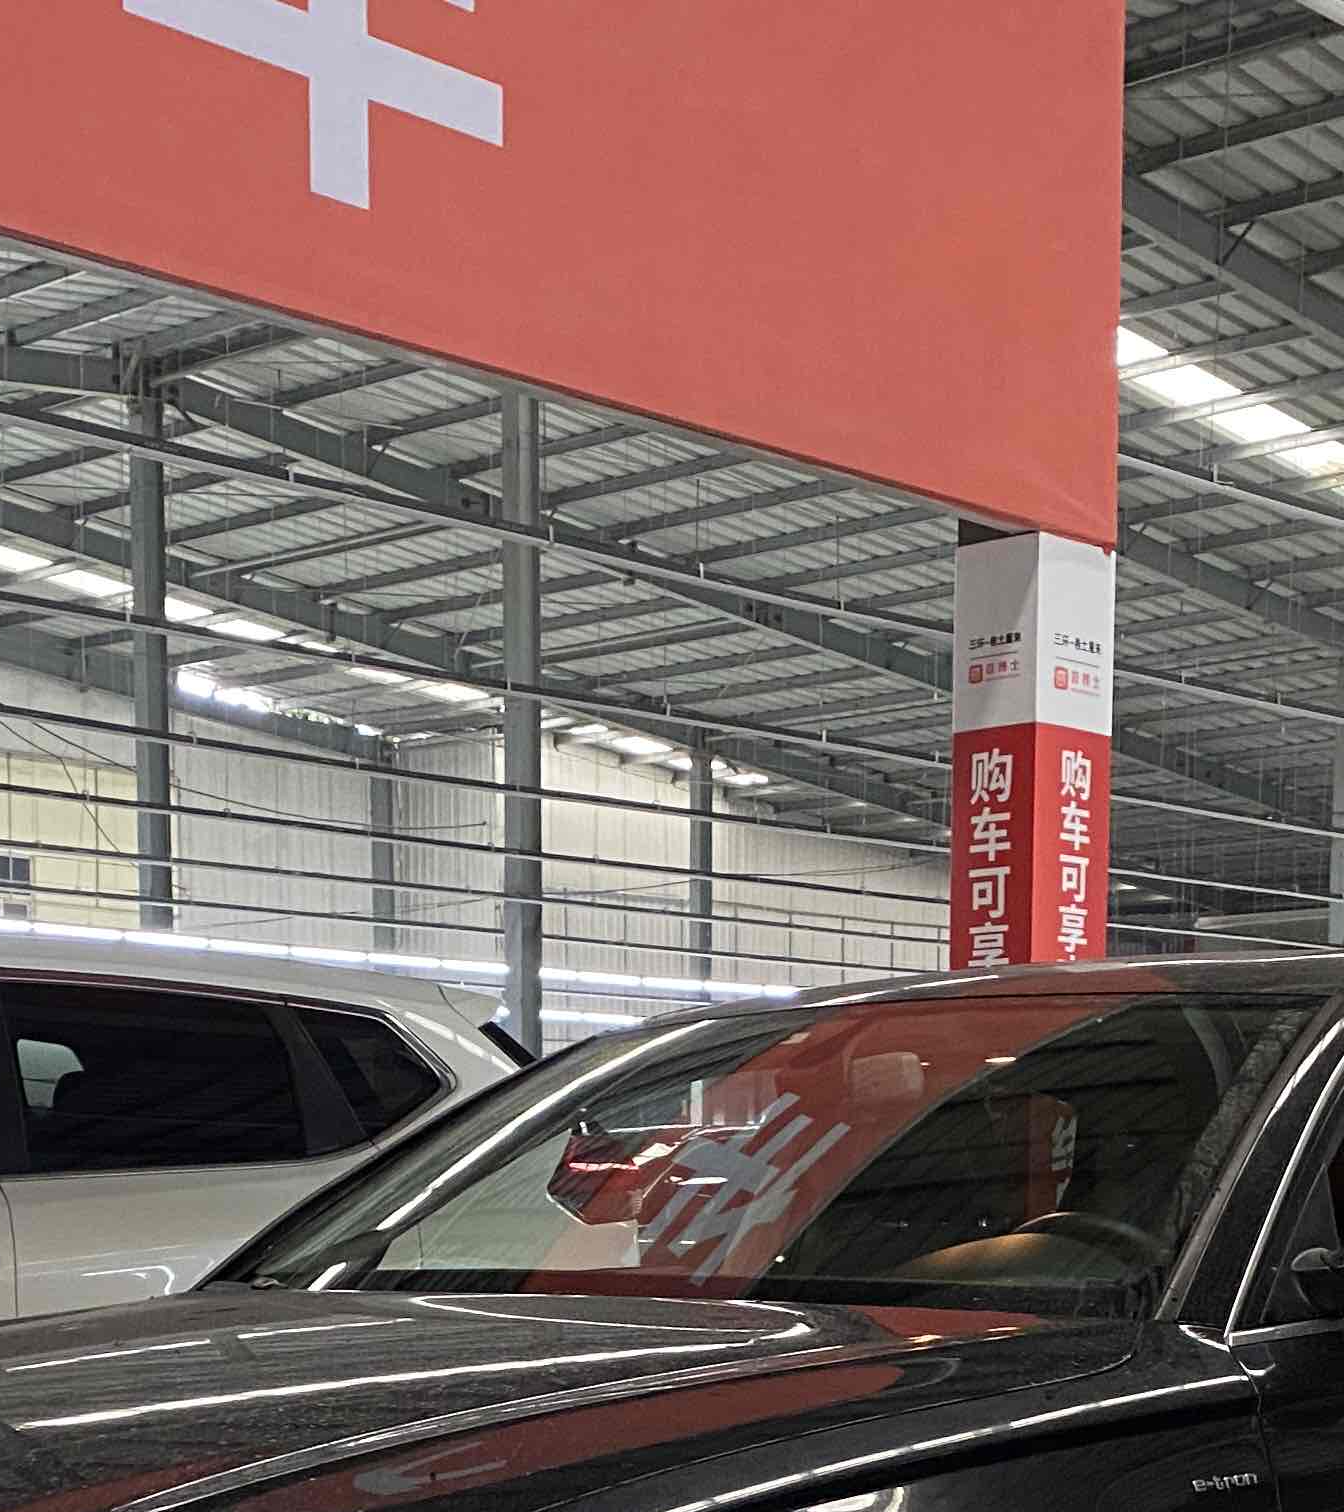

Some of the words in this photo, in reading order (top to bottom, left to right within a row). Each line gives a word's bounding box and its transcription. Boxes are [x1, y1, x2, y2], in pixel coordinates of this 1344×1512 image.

[968, 748, 1013, 967] 购车可享
[1057, 749, 1092, 961] 购车可享
[1192, 1471, 1259, 1493] e-tron
